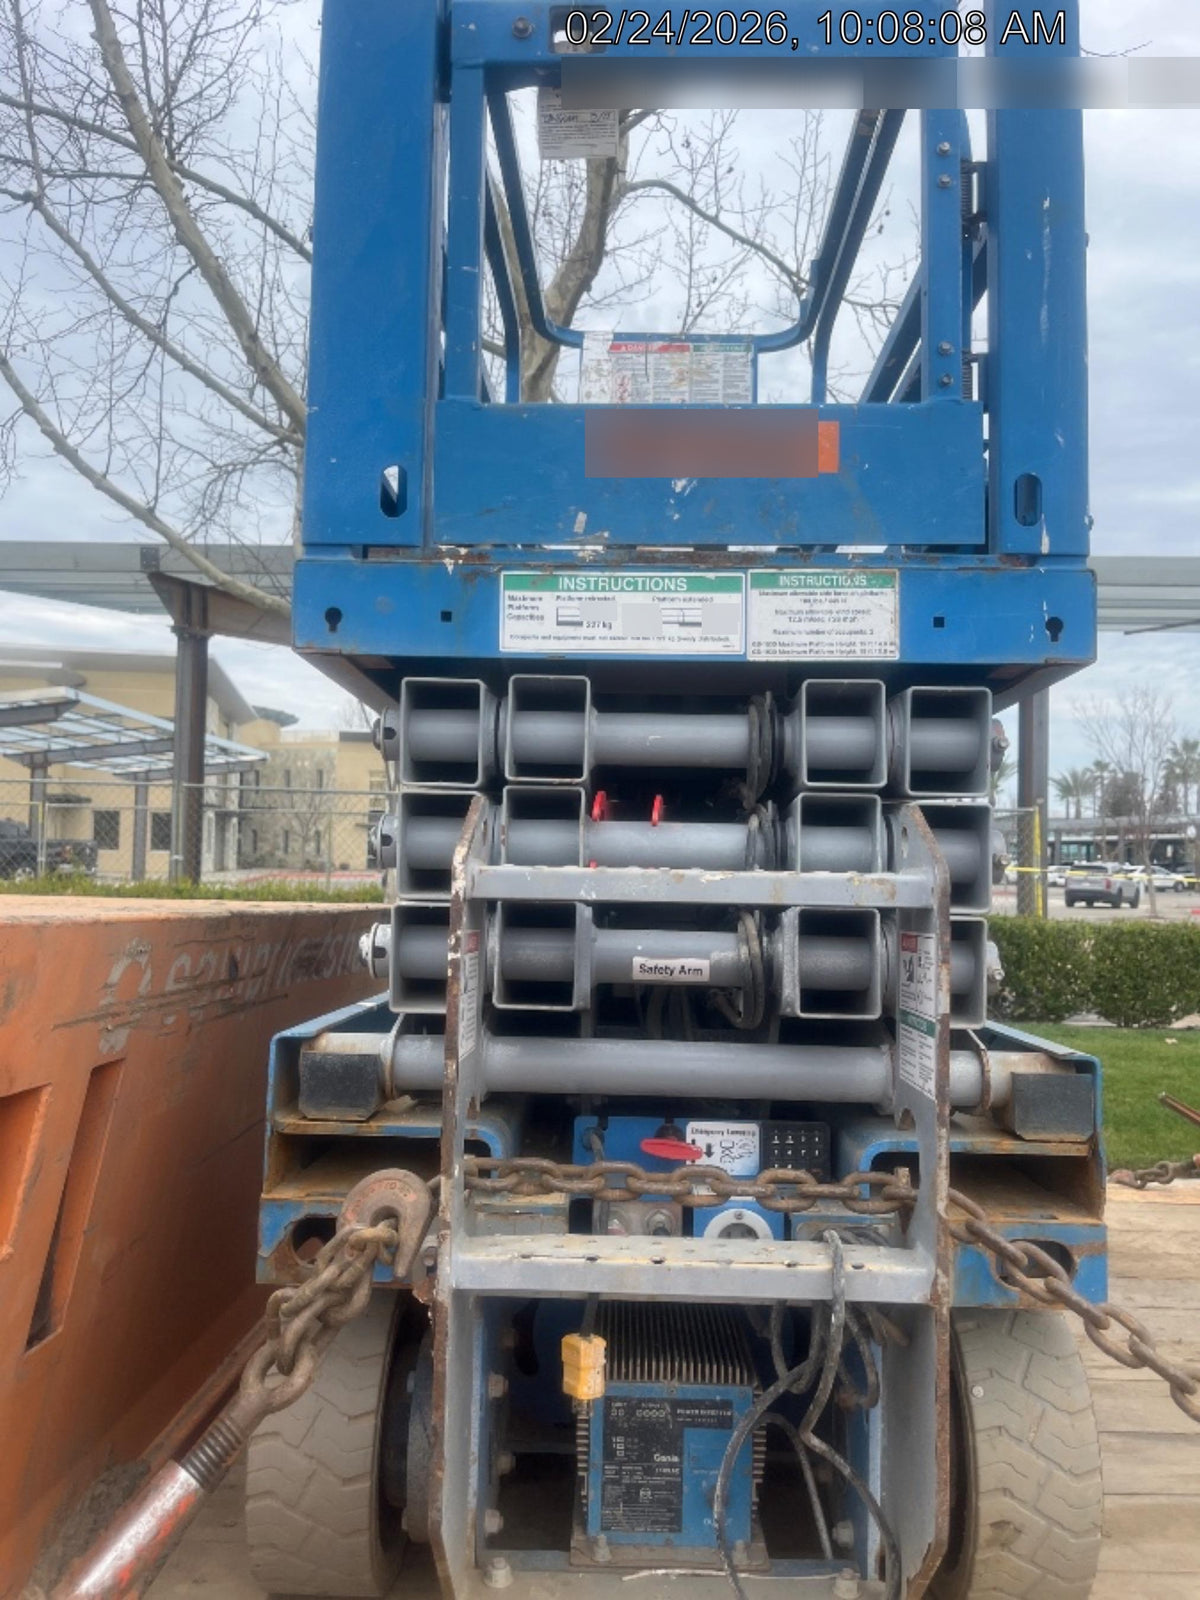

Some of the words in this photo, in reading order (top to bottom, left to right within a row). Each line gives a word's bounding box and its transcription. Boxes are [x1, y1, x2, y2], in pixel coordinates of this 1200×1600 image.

[559, 577, 688, 591] INSTRUCTIONS
[638, 963, 676, 977] Safety
[679, 965, 703, 976] Arm
